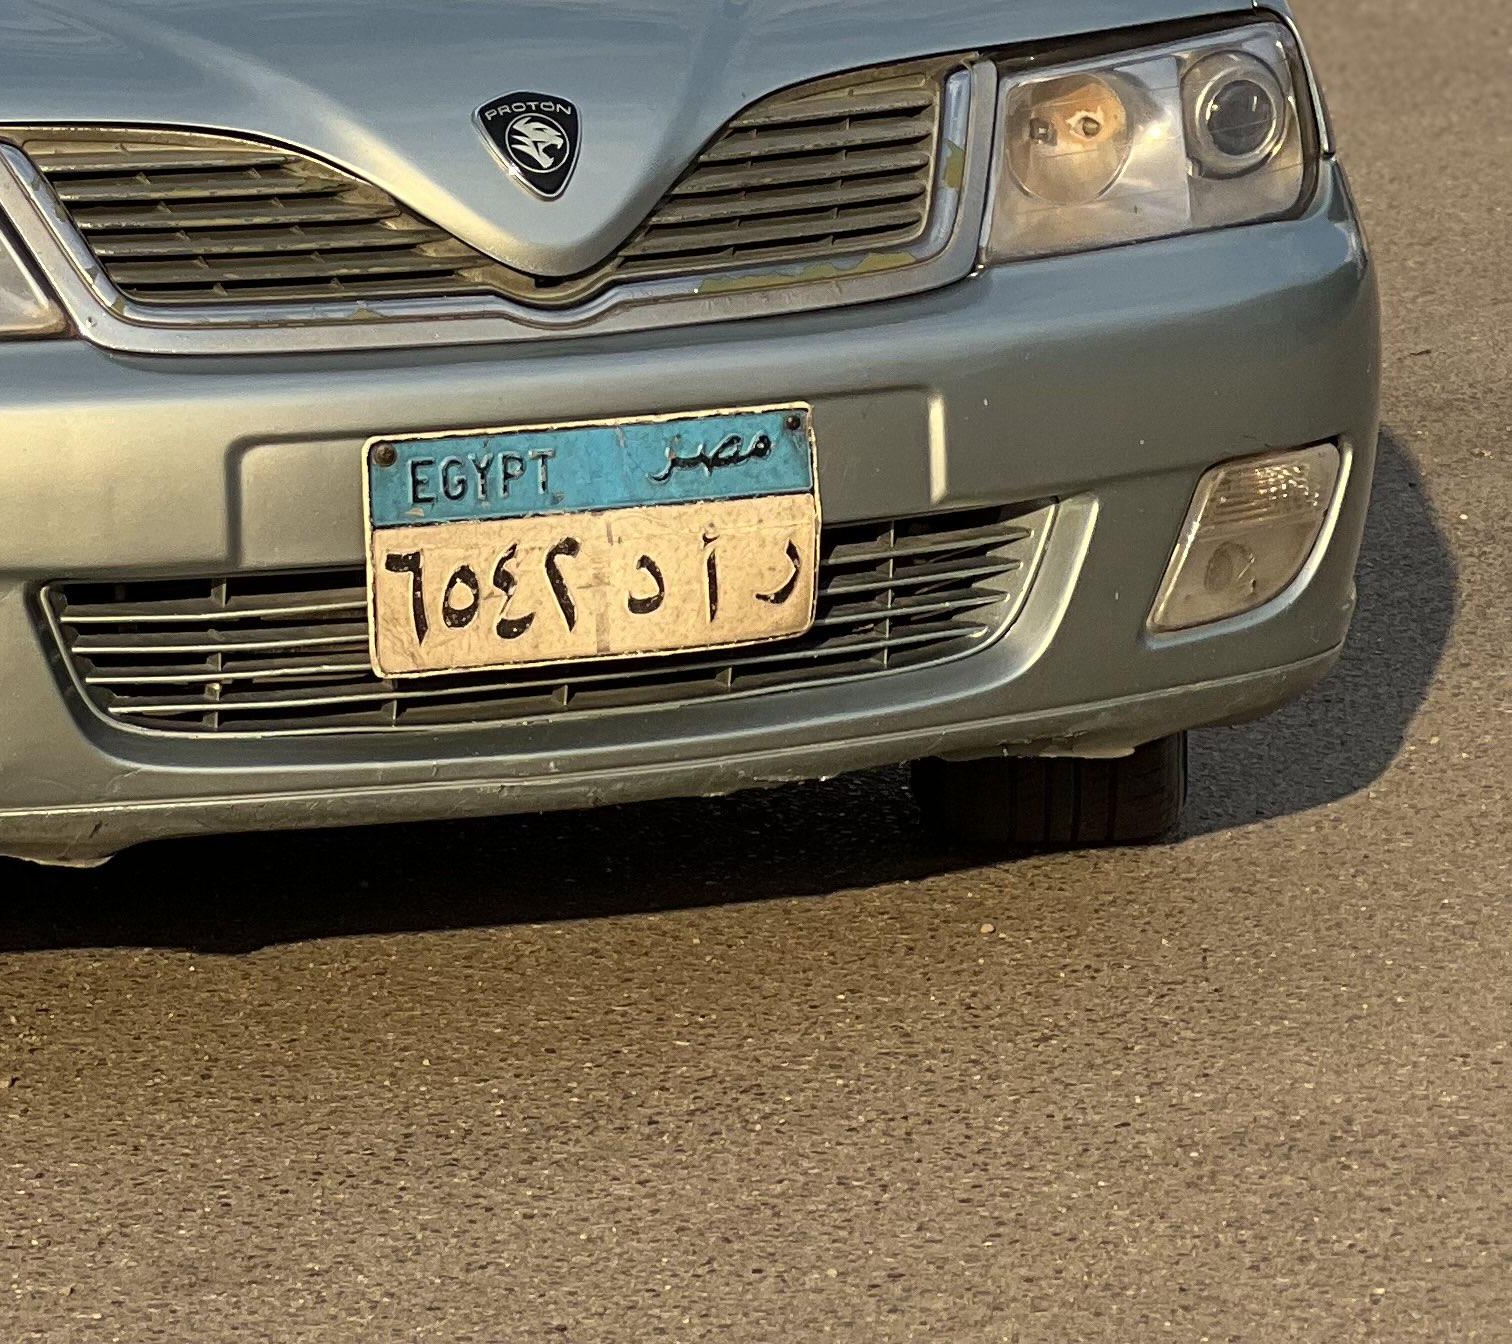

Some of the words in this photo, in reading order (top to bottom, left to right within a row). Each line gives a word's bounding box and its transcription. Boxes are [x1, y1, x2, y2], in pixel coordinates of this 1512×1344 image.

[484, 101, 572, 121] PROTON
[407, 447, 556, 507] EGYPT
[645, 431, 774, 485] مصر
[384, 535, 583, 648] ٦٥٤٢
